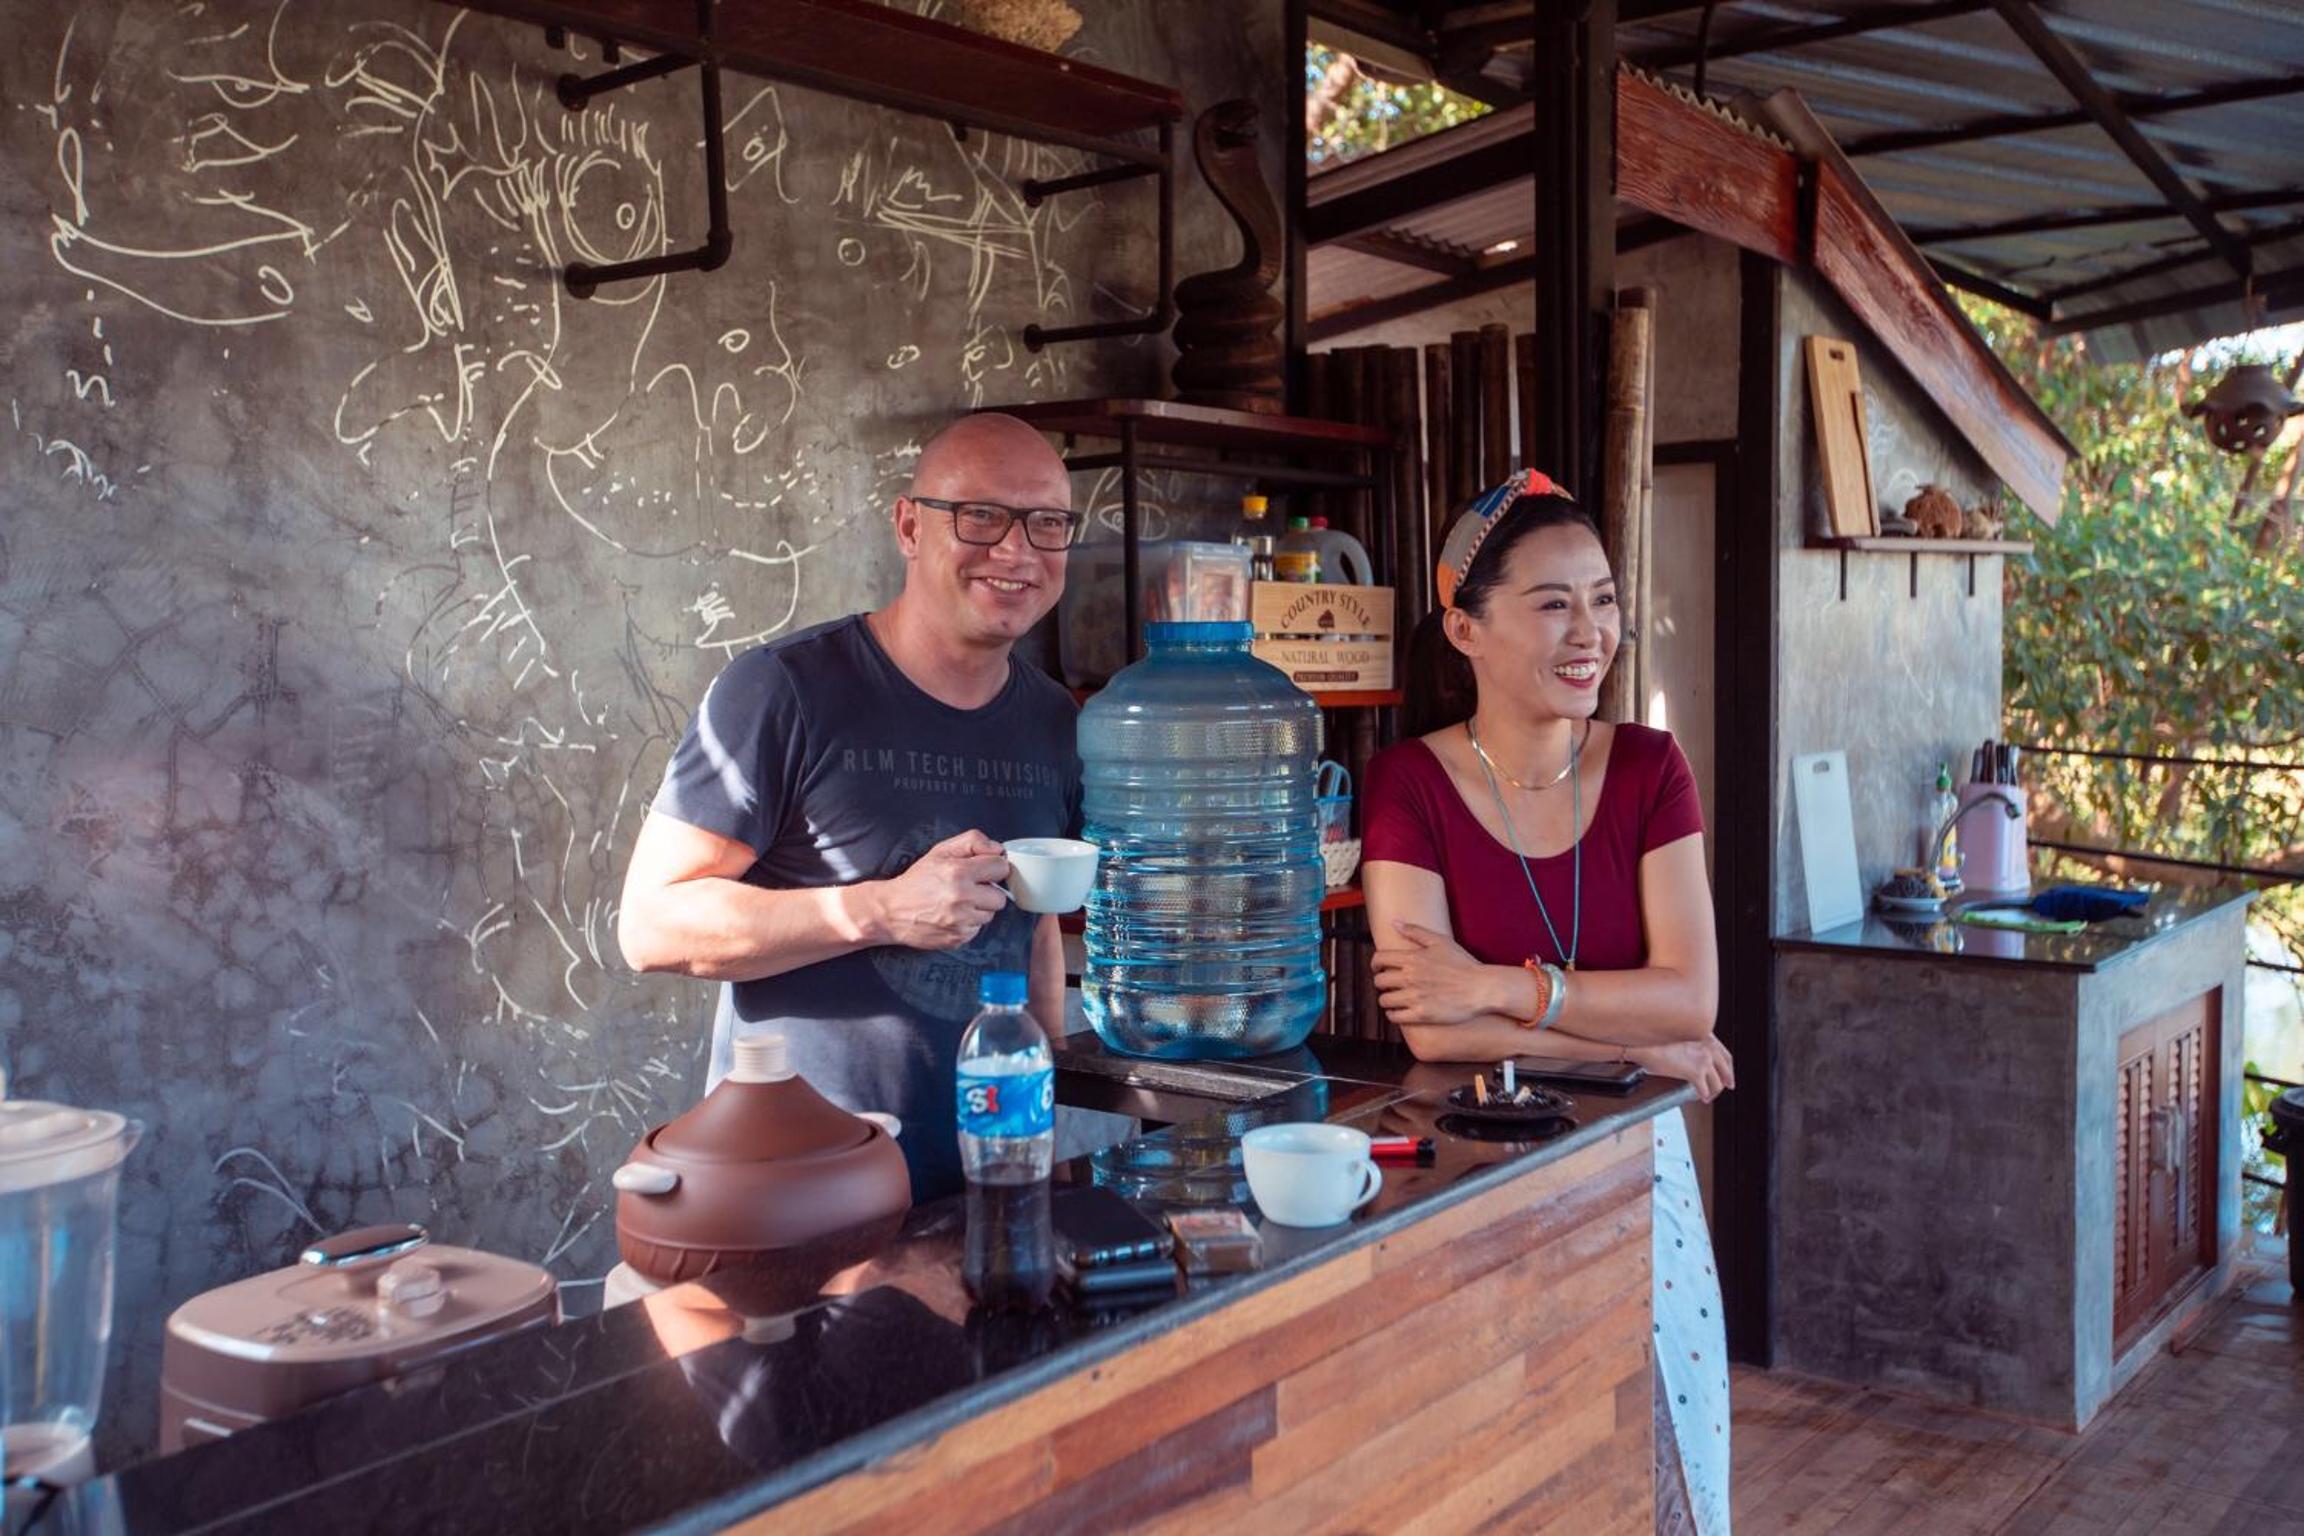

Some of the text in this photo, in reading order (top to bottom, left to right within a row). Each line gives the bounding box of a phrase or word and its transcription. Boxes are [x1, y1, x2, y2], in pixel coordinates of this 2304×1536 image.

[1280, 589, 1371, 630] COUNTRY STYLE
[1281, 649, 1371, 665] NATURAL WOOD
[842, 748, 895, 774] RLM
[905, 750, 966, 778] TECH
